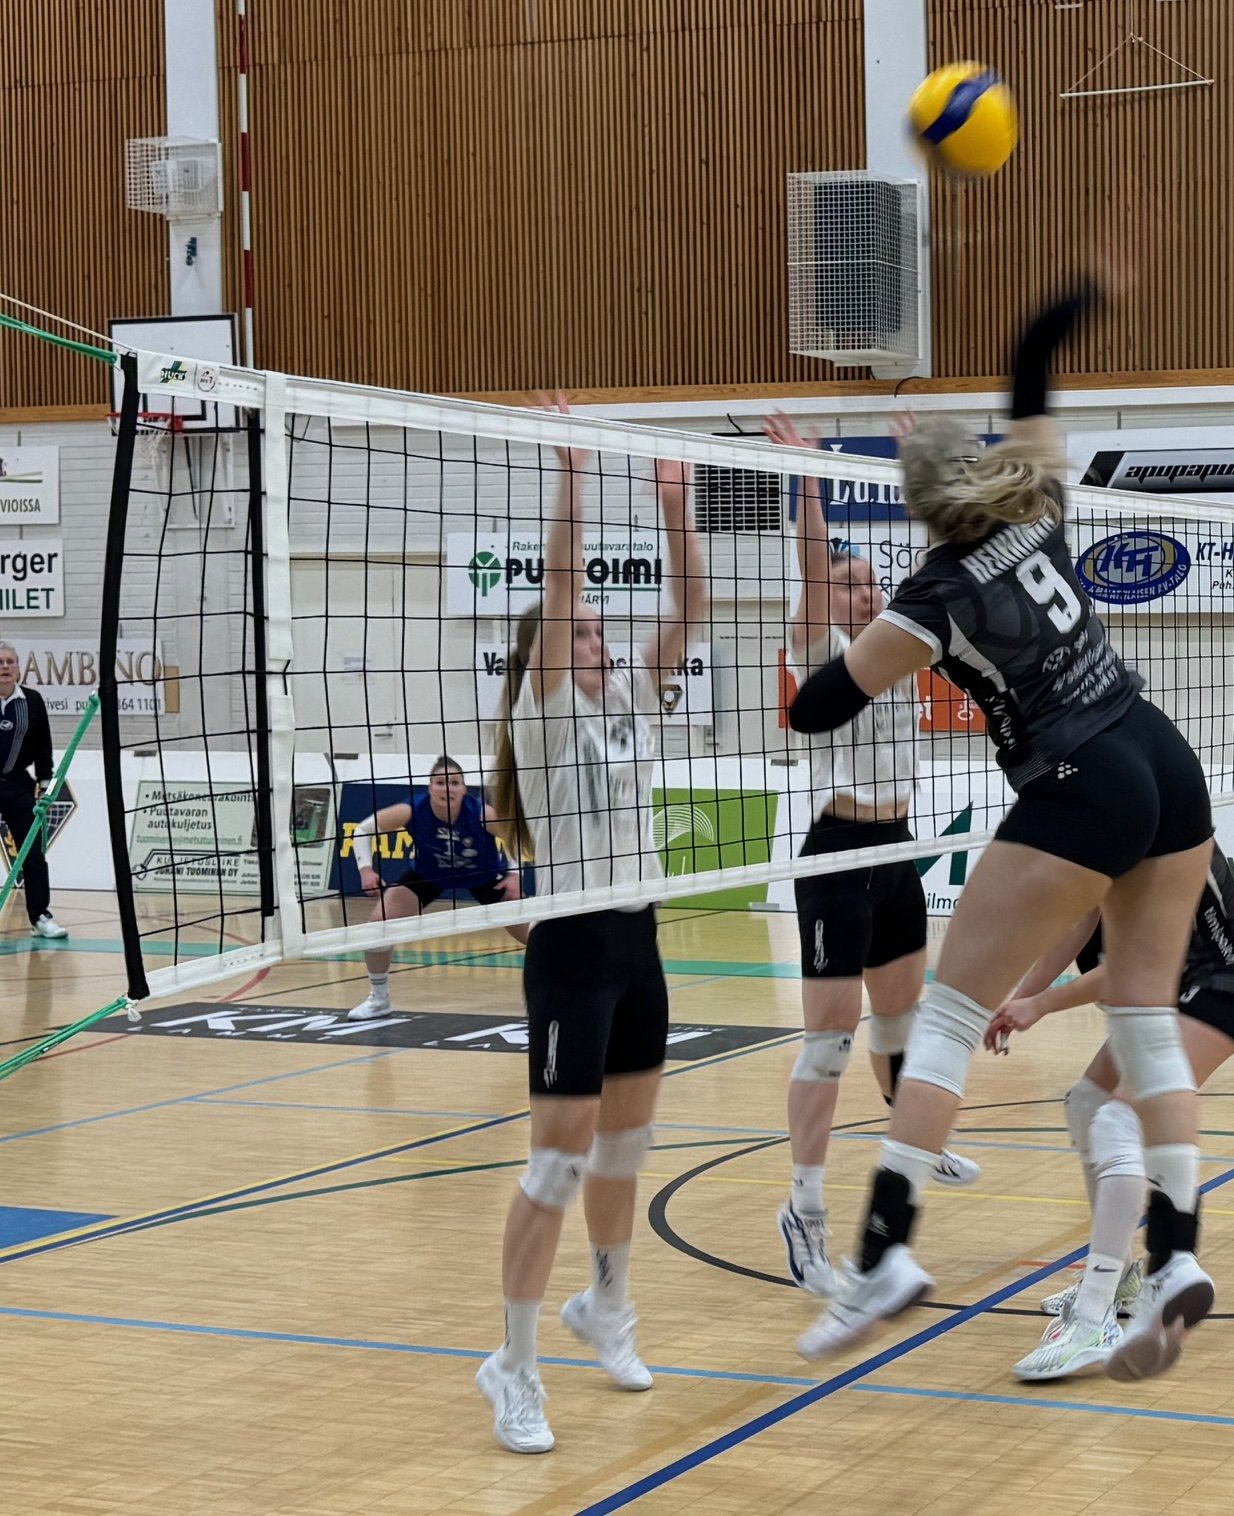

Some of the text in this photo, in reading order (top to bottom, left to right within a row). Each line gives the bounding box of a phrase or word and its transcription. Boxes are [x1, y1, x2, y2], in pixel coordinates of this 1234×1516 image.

[506, 557, 662, 585] PUOIMI
[0, 587, 55, 610] ILET
[1015, 549, 1082, 635] 9
[21, 650, 162, 686] AMBNO
